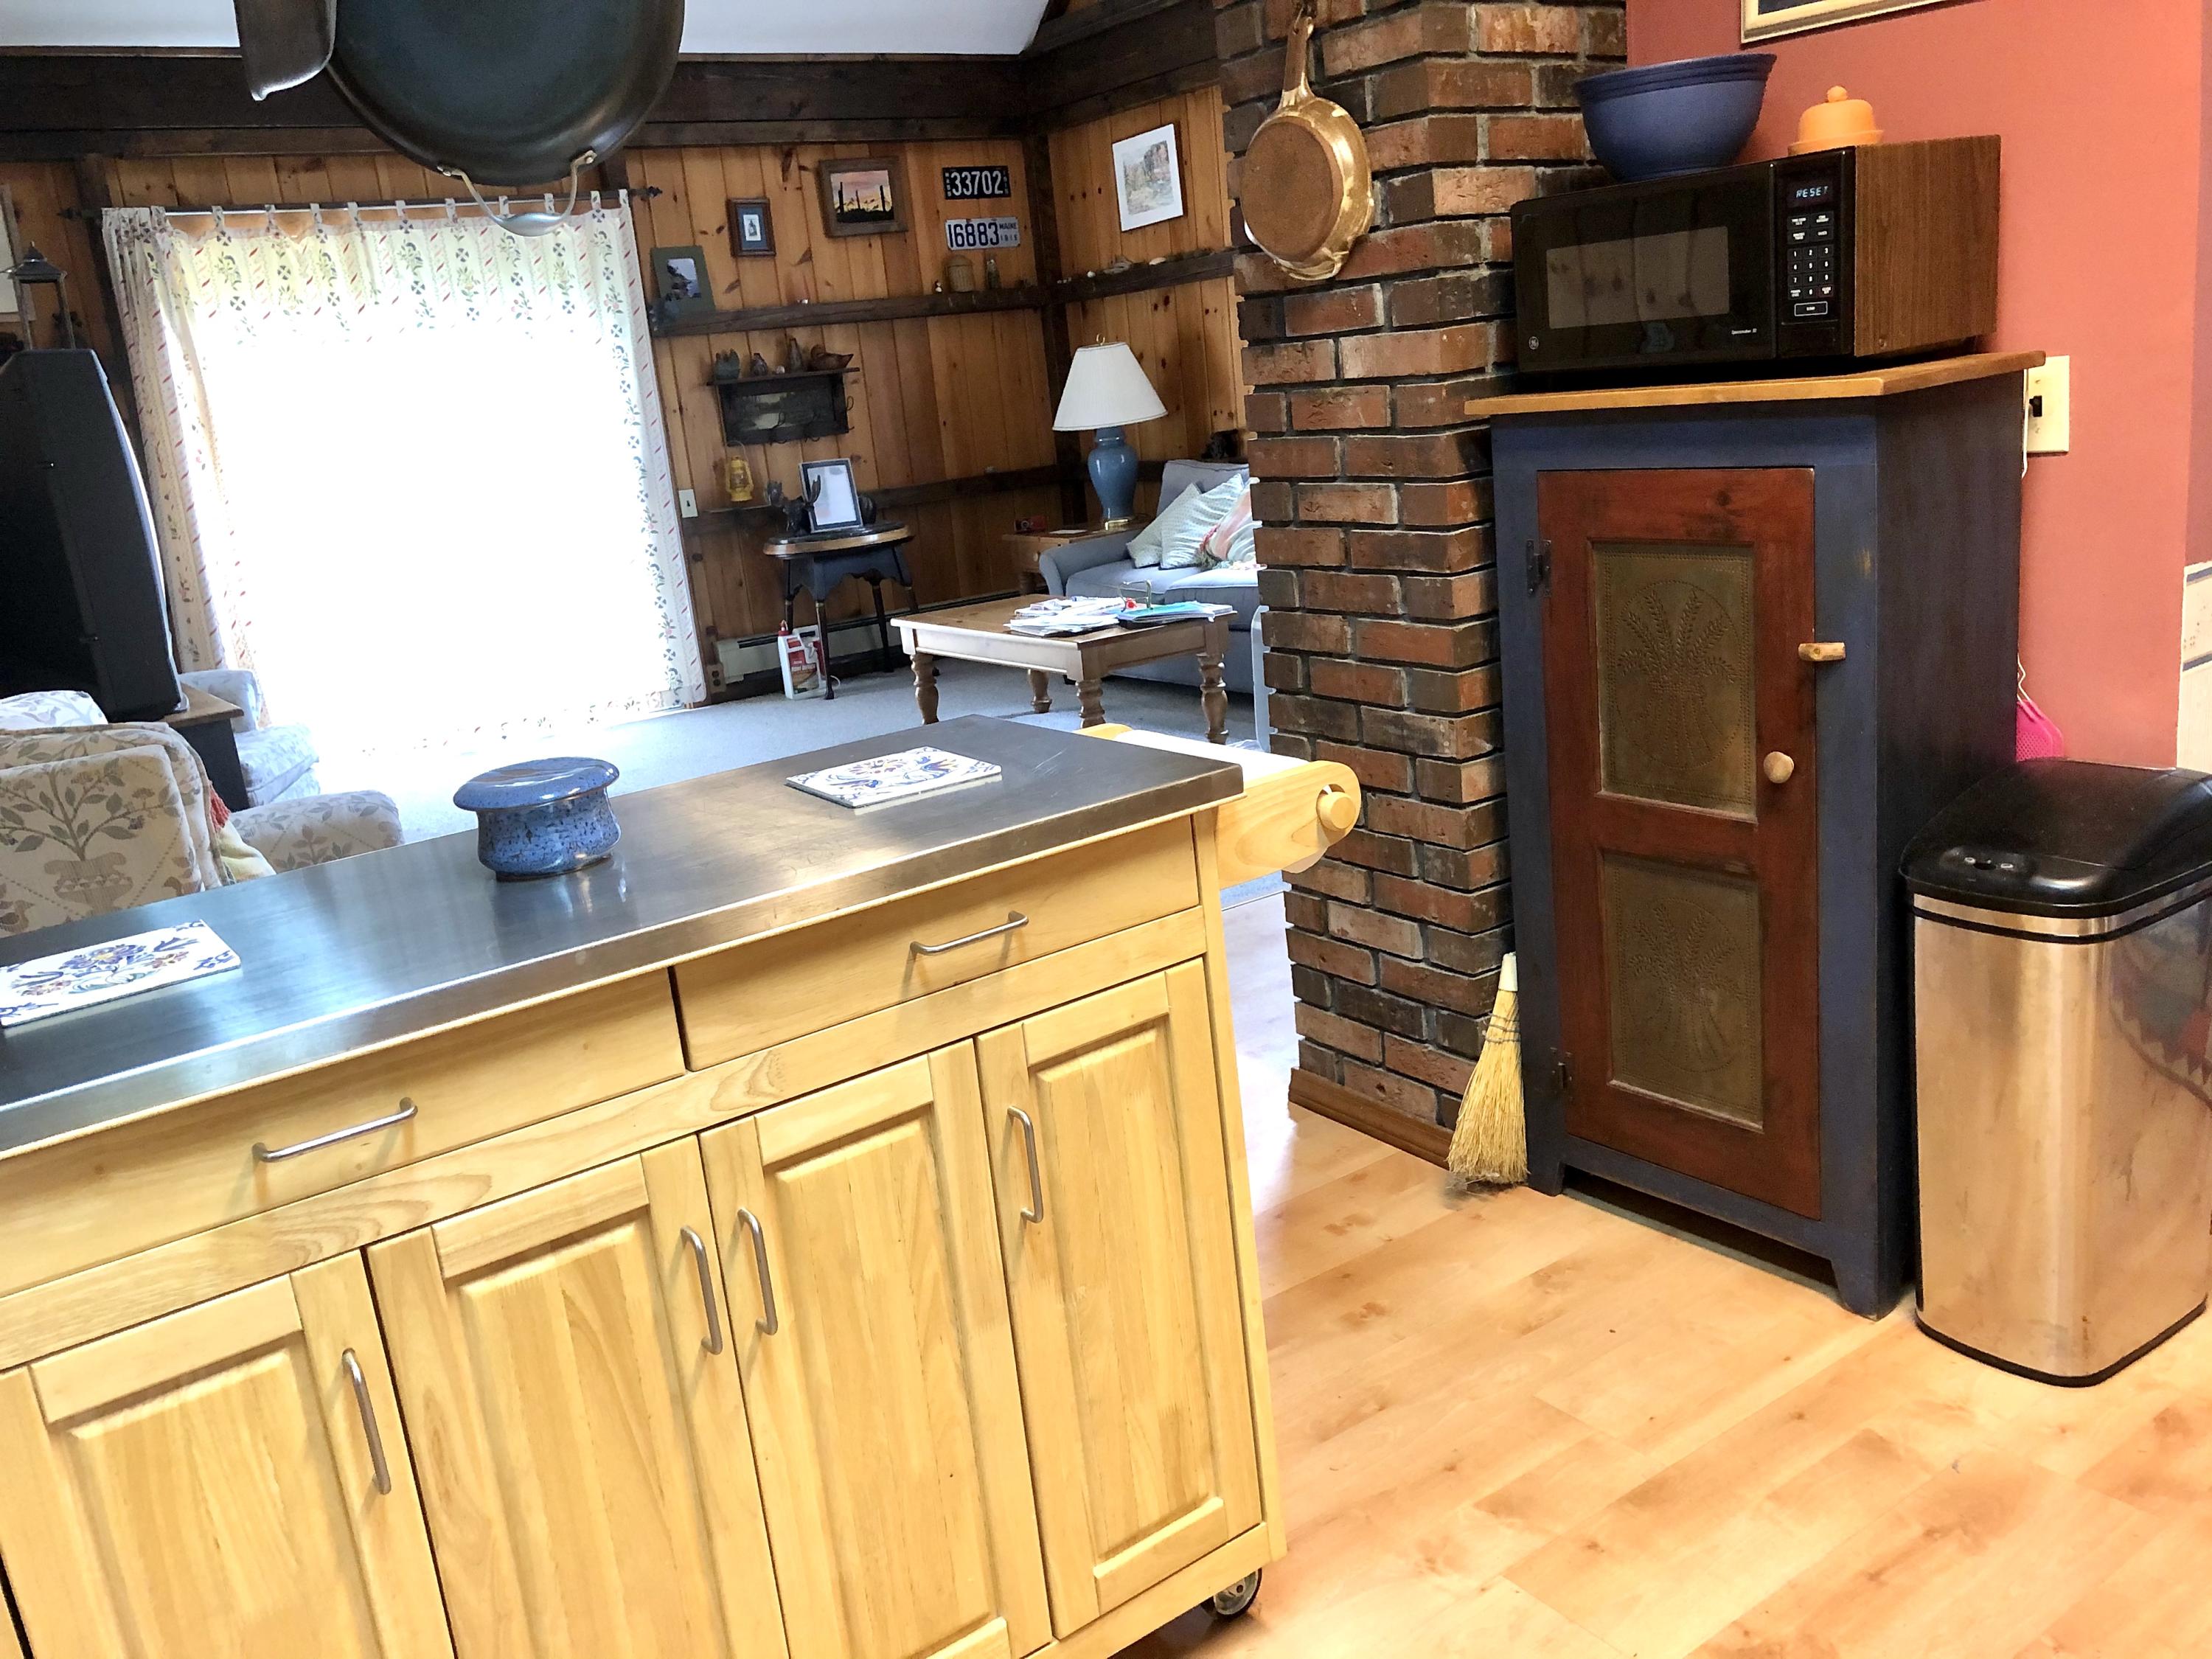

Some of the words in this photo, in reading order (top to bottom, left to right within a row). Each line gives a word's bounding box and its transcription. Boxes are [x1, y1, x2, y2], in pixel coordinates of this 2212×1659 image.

[950, 170, 1004, 196] 33702
[1796, 186, 1829, 198] RESET
[947, 222, 1000, 248] 16883
